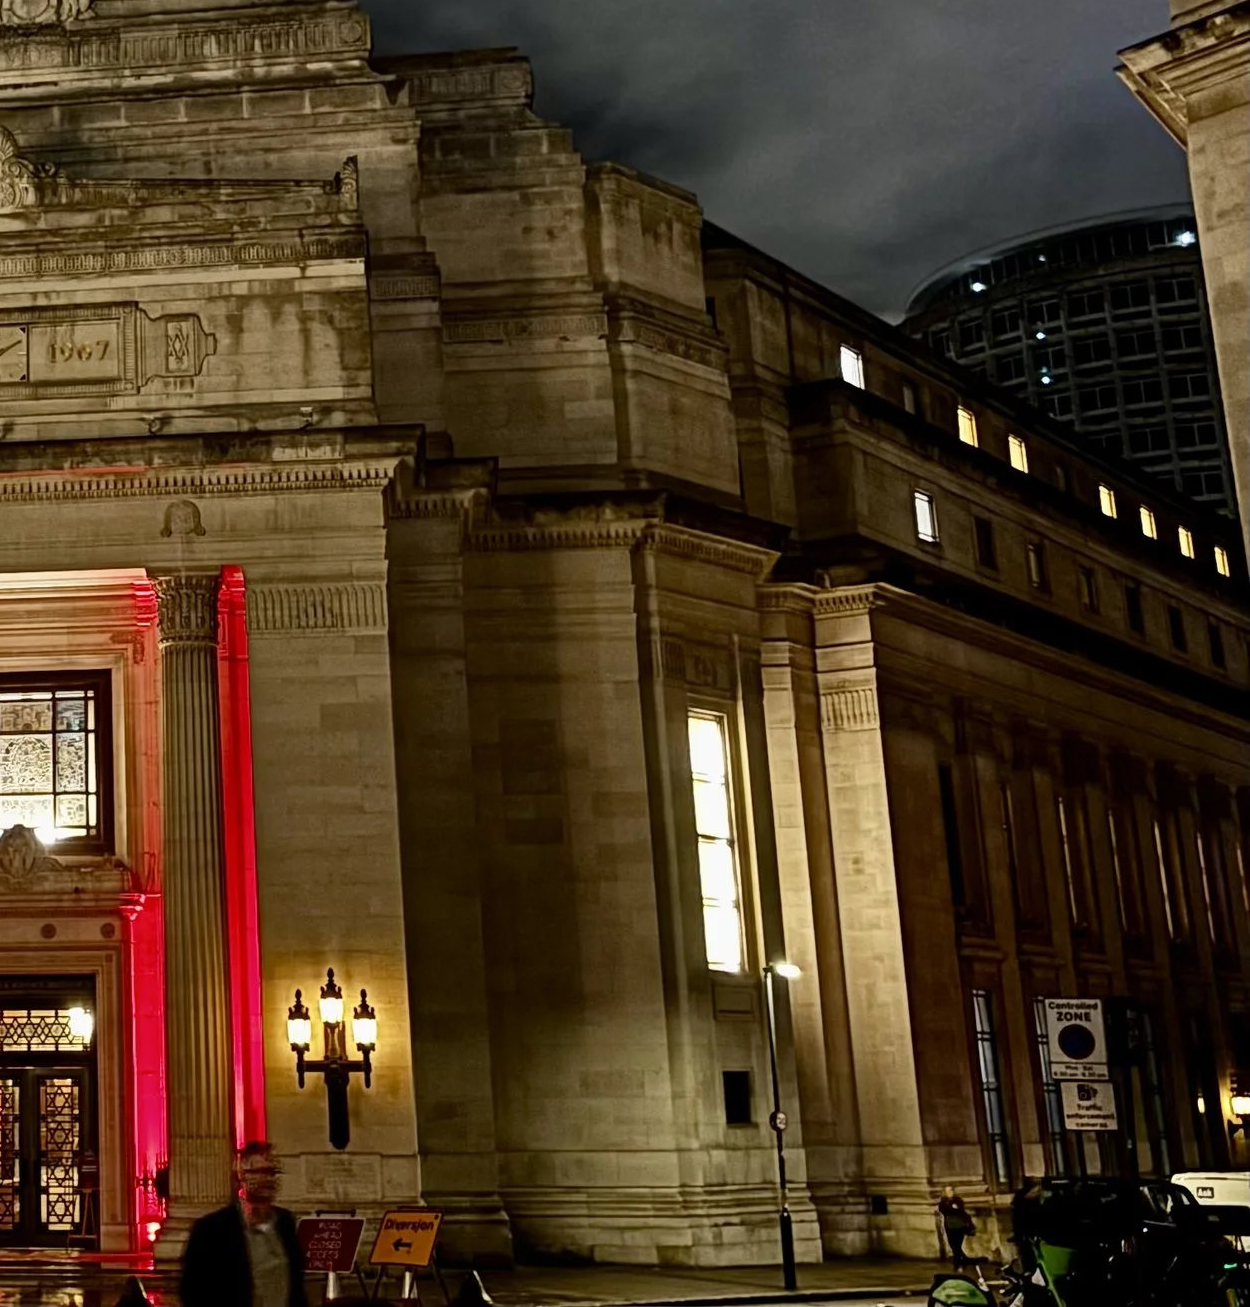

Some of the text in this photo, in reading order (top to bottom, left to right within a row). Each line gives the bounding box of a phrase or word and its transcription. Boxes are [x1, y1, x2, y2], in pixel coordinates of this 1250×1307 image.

[1048, 1001, 1098, 1010] Controlled
[1056, 1011, 1091, 1022] ZONE
[1077, 1103, 1103, 1111] Traffic
[384, 1218, 435, 1231] Diversion
